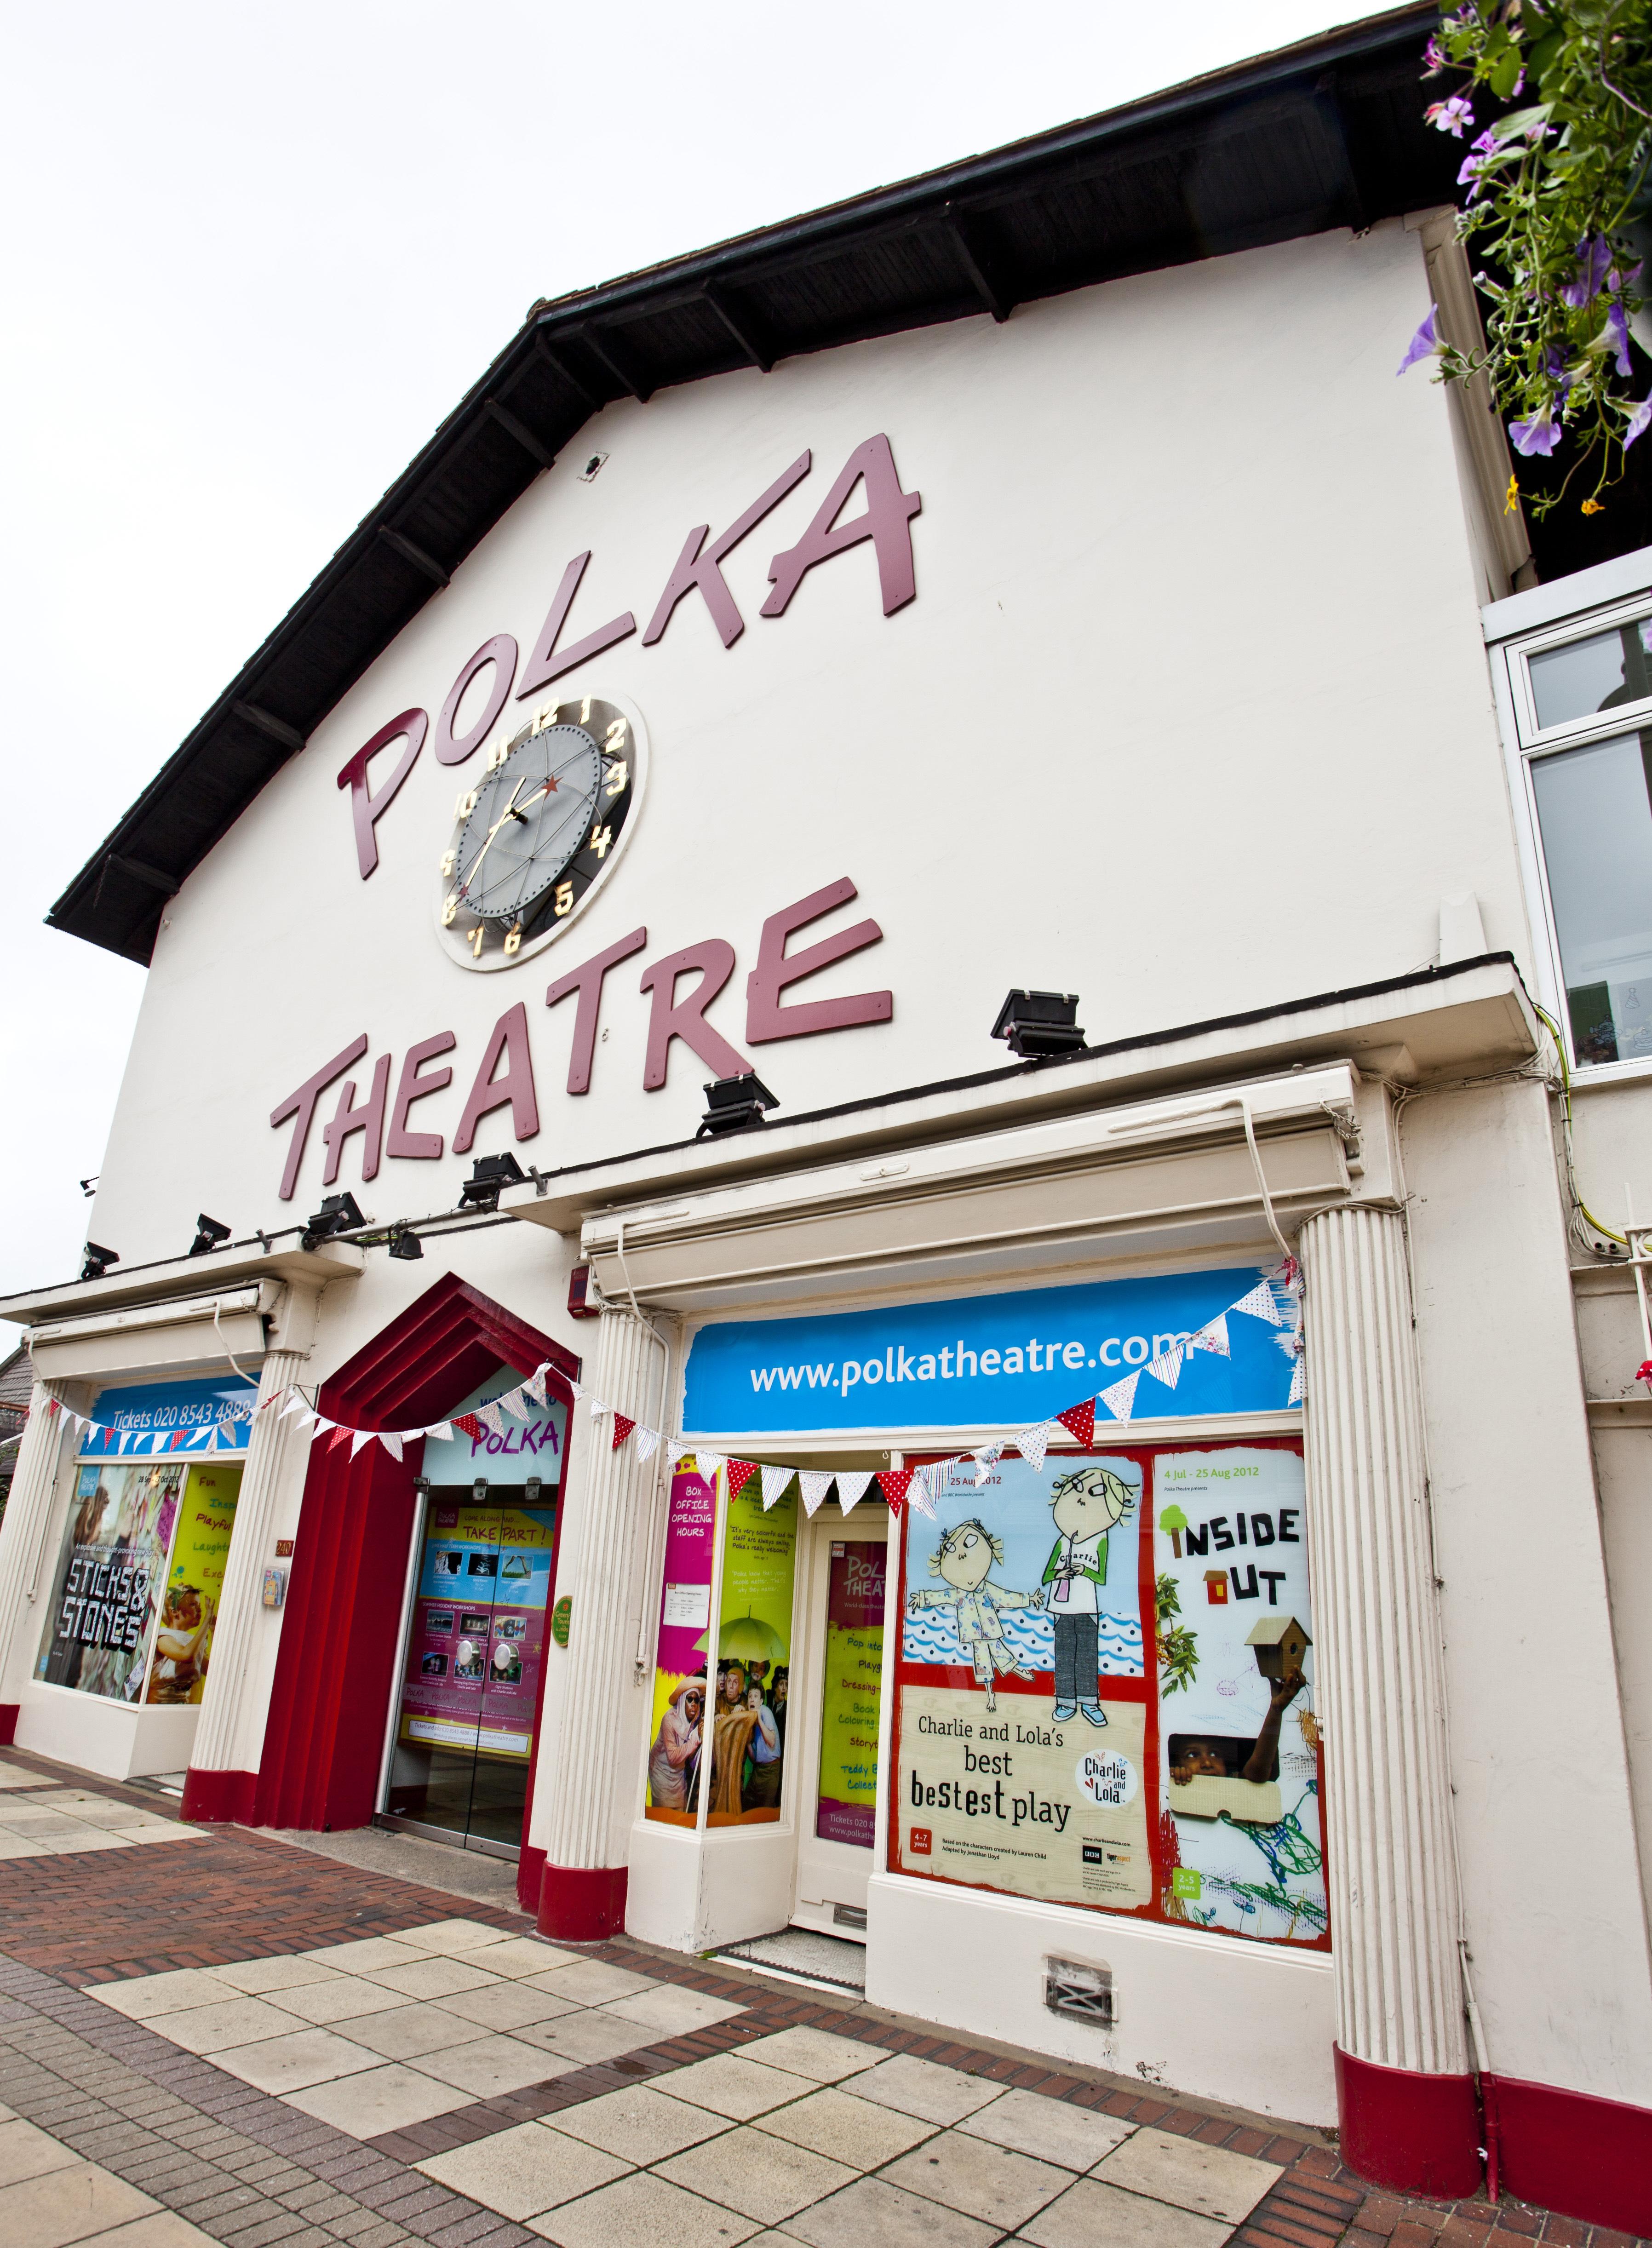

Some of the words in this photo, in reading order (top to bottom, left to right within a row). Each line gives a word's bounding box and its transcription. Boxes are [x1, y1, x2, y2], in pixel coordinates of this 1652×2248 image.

[337, 432, 920, 880] POLKA
[531, 697, 559, 736] 12
[605, 717, 627, 753] 2
[487, 735, 508, 772] 11
[607, 761, 627, 796] 3
[453, 791, 477, 821] 10
[590, 826, 612, 858] 4
[440, 849, 457, 877] 9
[554, 881, 573, 916] 5
[441, 895, 456, 926] 8
[468, 925, 484, 958] 7
[504, 923, 522, 955] 6
[270, 876, 893, 1201] THEATRE
[750, 1331, 1194, 1397] www.polkatheatre.com
[113, 1409, 151, 1429] Tickets
[154, 1406, 177, 1427] 020
[179, 1403, 212, 1425] 8543
[471, 1420, 558, 1458] POLKA
[199, 1477, 216, 1486] Fun
[1164, 1470, 1170, 1479] 4
[1173, 1470, 1186, 1481] Jul
[1196, 1469, 1209, 1478] 25
[1210, 1468, 1231, 1480] Aug
[1233, 1467, 1259, 1476] 2012
[676, 1500, 709, 1509] OFFICE
[196, 1513, 231, 1531] Playful
[671, 1514, 711, 1523] OPENING
[463, 1526, 497, 1540] TAKE
[502, 1527, 537, 1541] PART
[677, 1527, 704, 1537] HOURS
[1170, 1508, 1300, 1559] INSIDE
[276, 1542, 292, 1554] 240
[203, 1568, 224, 1578] Exc
[847, 1556, 886, 1578] POL
[67, 1558, 133, 1601] STICKS
[130, 1569, 150, 1611] &
[59, 1595, 142, 1648] STONES
[848, 1637, 863, 1649] Pop
[867, 1641, 882, 1651] into
[859, 1660, 882, 1673] Playg
[842, 1679, 881, 1695] Dressing-
[853, 1703, 874, 1713] Book
[838, 1714, 874, 1729] Colouring
[918, 1716, 973, 1738] Charlie
[979, 1723, 1009, 1741] and
[1016, 1725, 1063, 1747] Lola's
[841, 1764, 868, 1778] Teddy
[964, 1745, 1013, 1776] best
[1085, 1757, 1125, 1780] Charlie
[847, 1779, 877, 1789] Collect
[1096, 1782, 1120, 1803] Lola
[1114, 1781, 1125, 1789] and
[912, 1770, 1006, 1819] bestest
[1012, 1791, 1071, 1833] play
[830, 1814, 853, 1825] Tickets
[855, 1819, 867, 1828] 020
[970, 1843, 992, 1851] characters
[1083, 1837, 1130, 1847] www.charlieandlola.com
